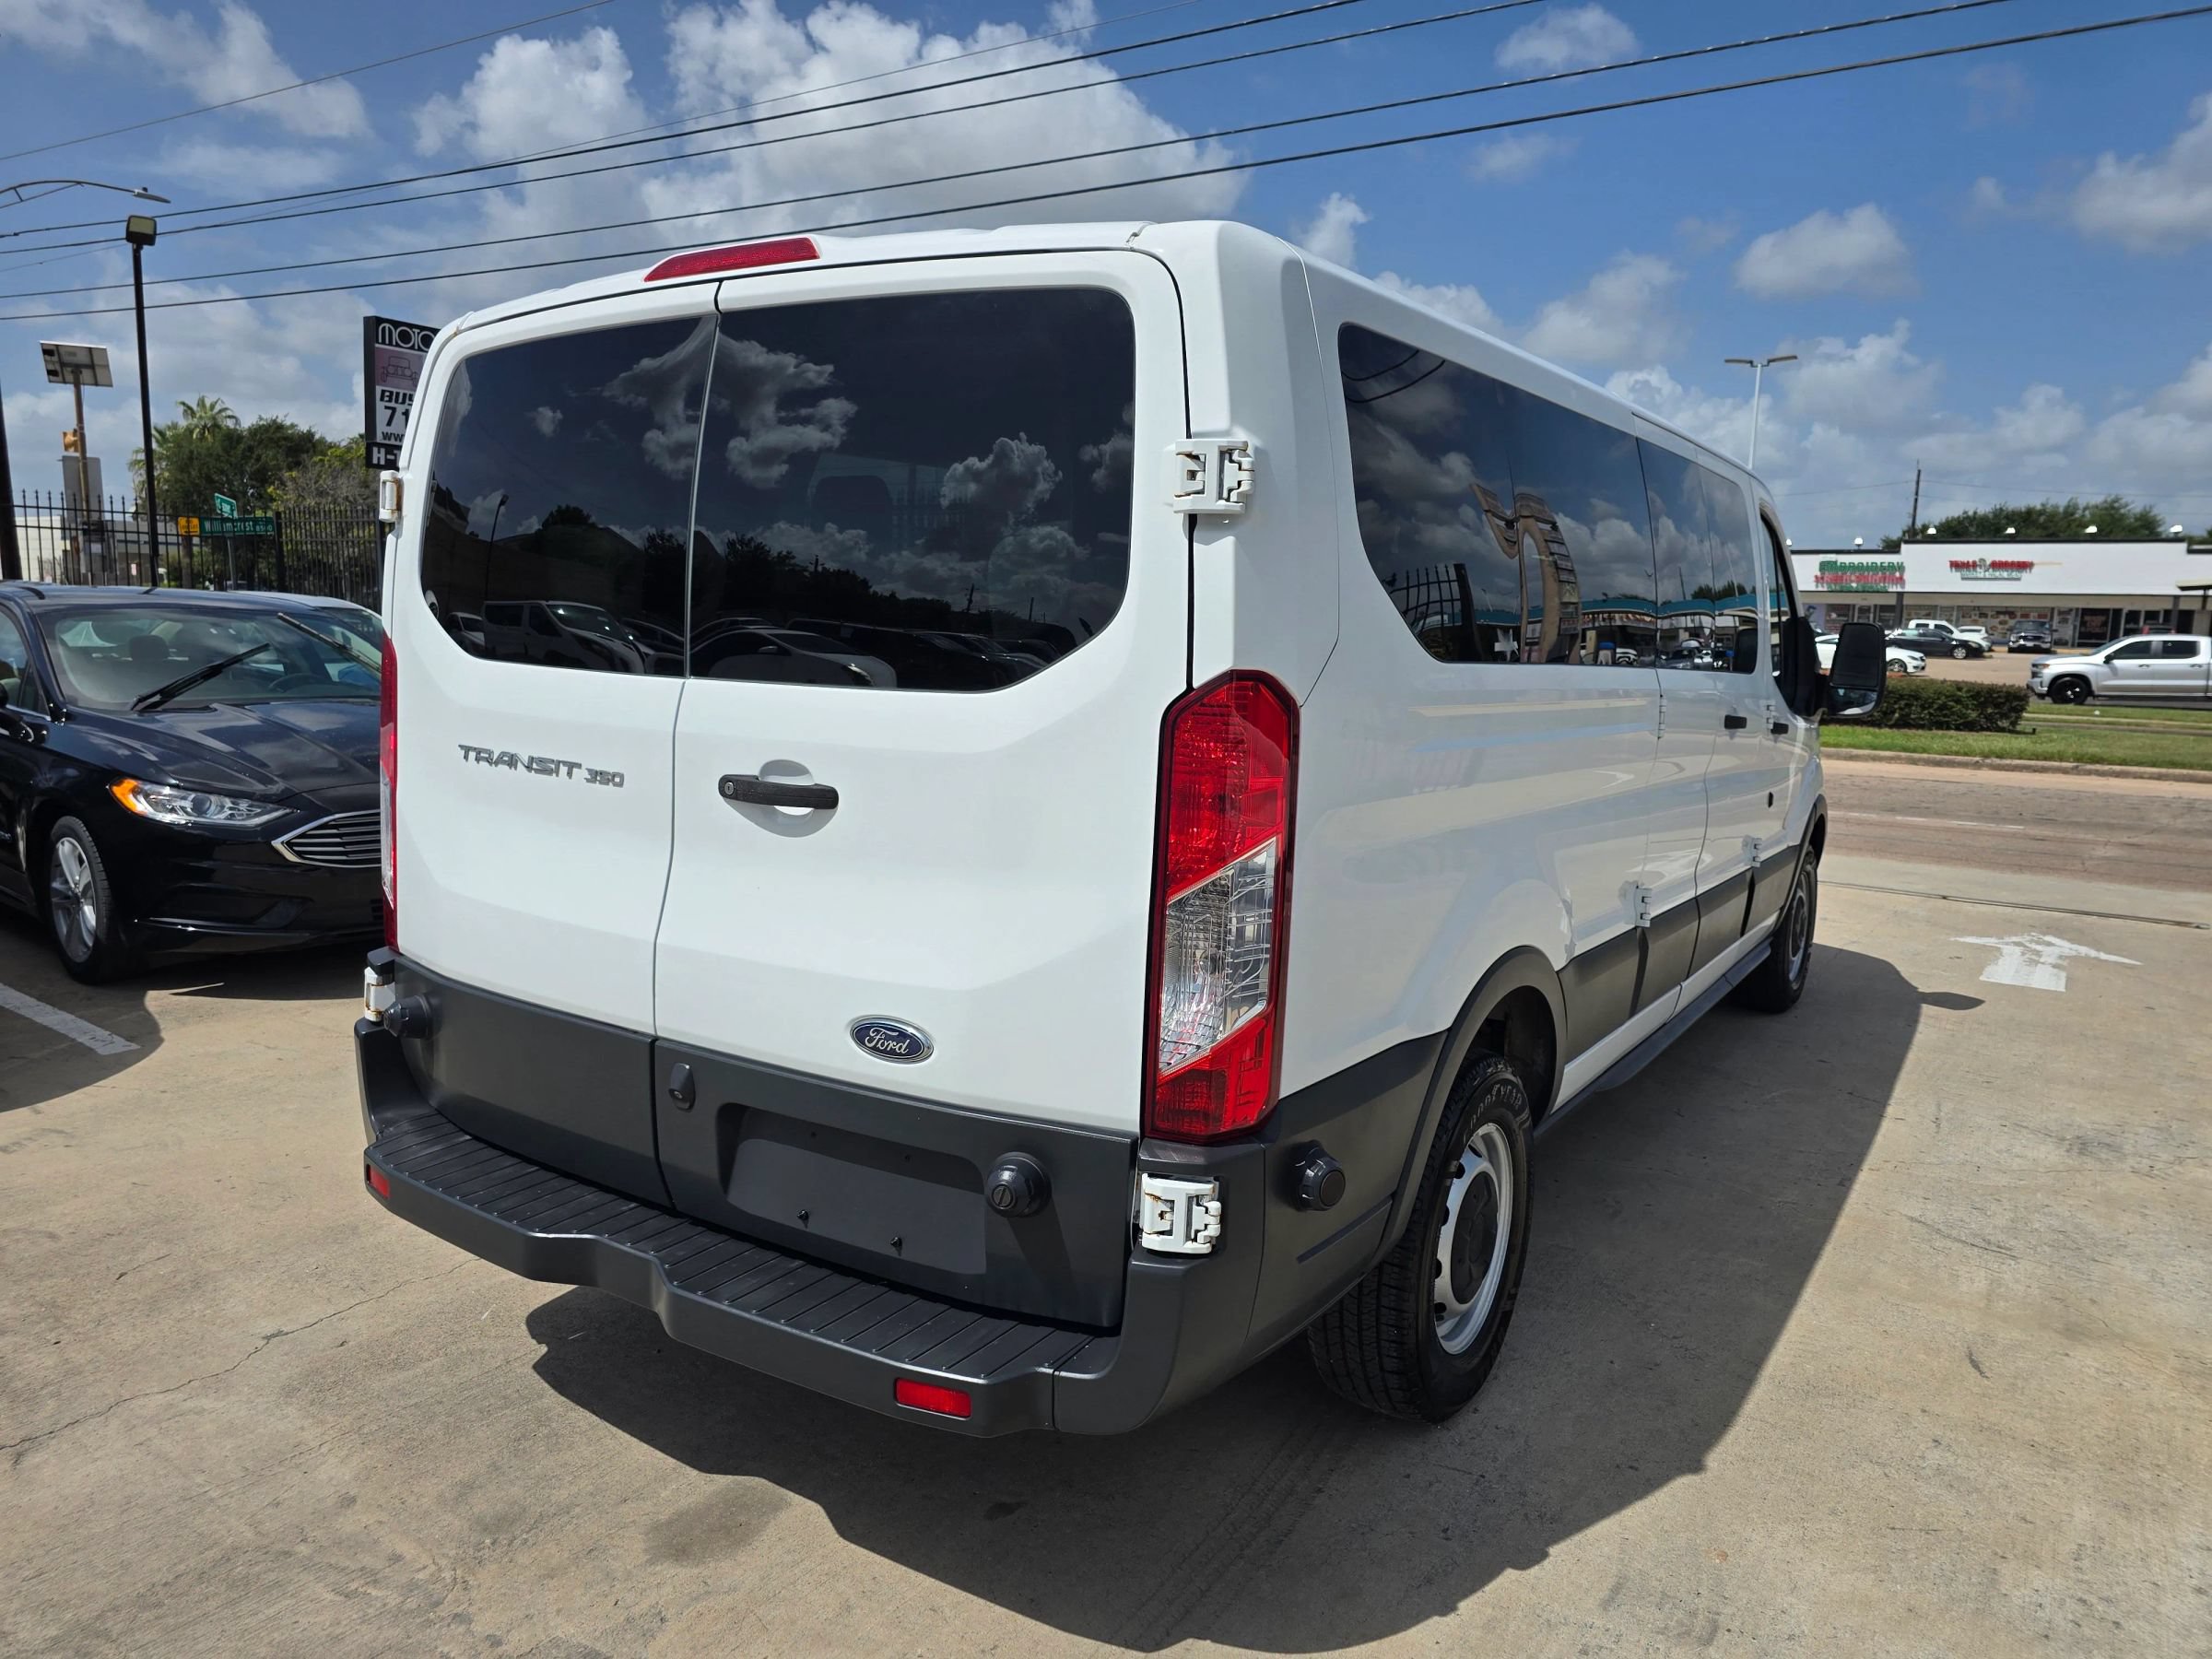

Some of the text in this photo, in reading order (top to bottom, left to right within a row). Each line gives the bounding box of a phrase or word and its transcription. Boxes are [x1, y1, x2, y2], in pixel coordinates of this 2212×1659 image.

[458, 744, 624, 788] TRANSIT 350
[865, 1027, 911, 1053] Ford
